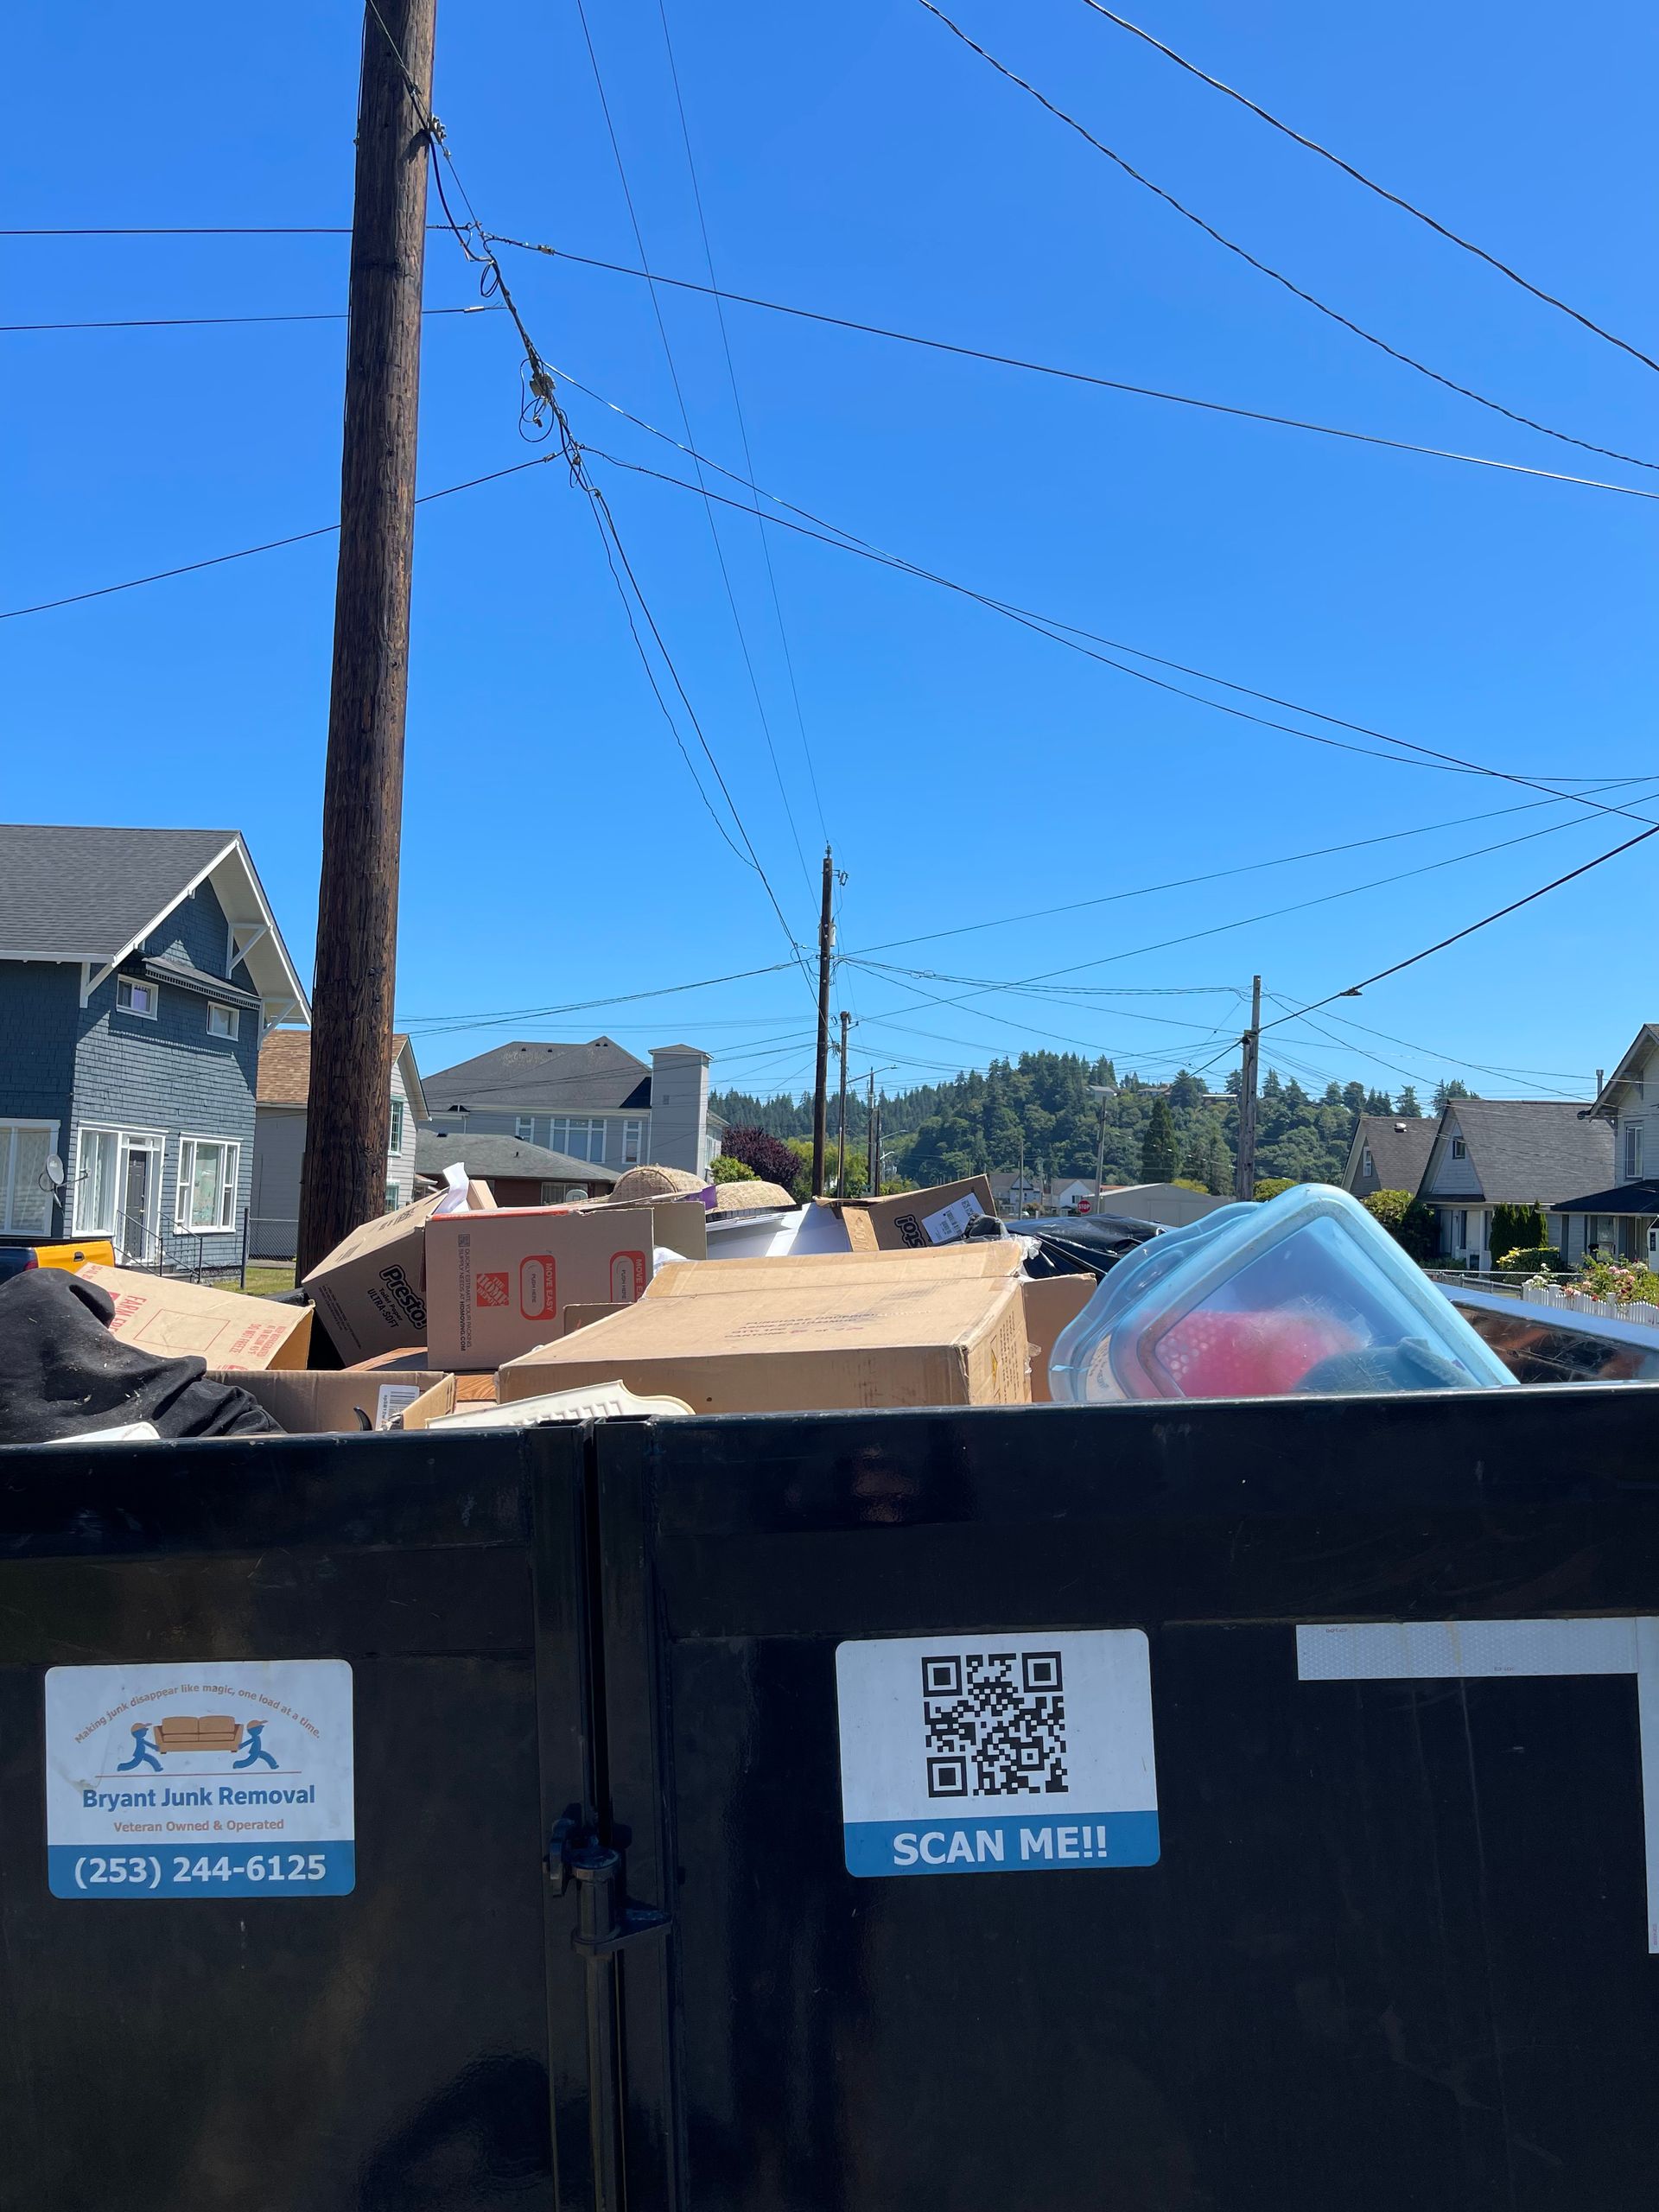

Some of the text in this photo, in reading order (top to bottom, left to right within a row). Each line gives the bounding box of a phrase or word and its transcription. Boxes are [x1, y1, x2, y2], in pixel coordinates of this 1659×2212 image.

[380, 1265, 427, 1329] Presto!
[477, 1274, 508, 1305] HOME
[477, 1287, 499, 1306] DEPOT
[493, 1277, 505, 1288] THE
[116, 1295, 147, 1317] FARM
[378, 1287, 403, 1321] Toilet Paper
[74, 1716, 107, 1744] Making
[107, 1702, 130, 1721] junk
[130, 1687, 178, 1707] disappear
[181, 1684, 200, 1693] like
[202, 1685, 235, 1696] magic,
[238, 1688, 257, 1700] one
[258, 1694, 281, 1710] load
[280, 1705, 291, 1716] at
[299, 1717, 321, 1738] time.
[83, 1785, 315, 1812] Bryant Junk Removal
[114, 1819, 284, 1833] Veteran Owned & Operated
[893, 1825, 1107, 1866] SCAN ME!!
[74, 1854, 326, 1890] (253) 244-6125
